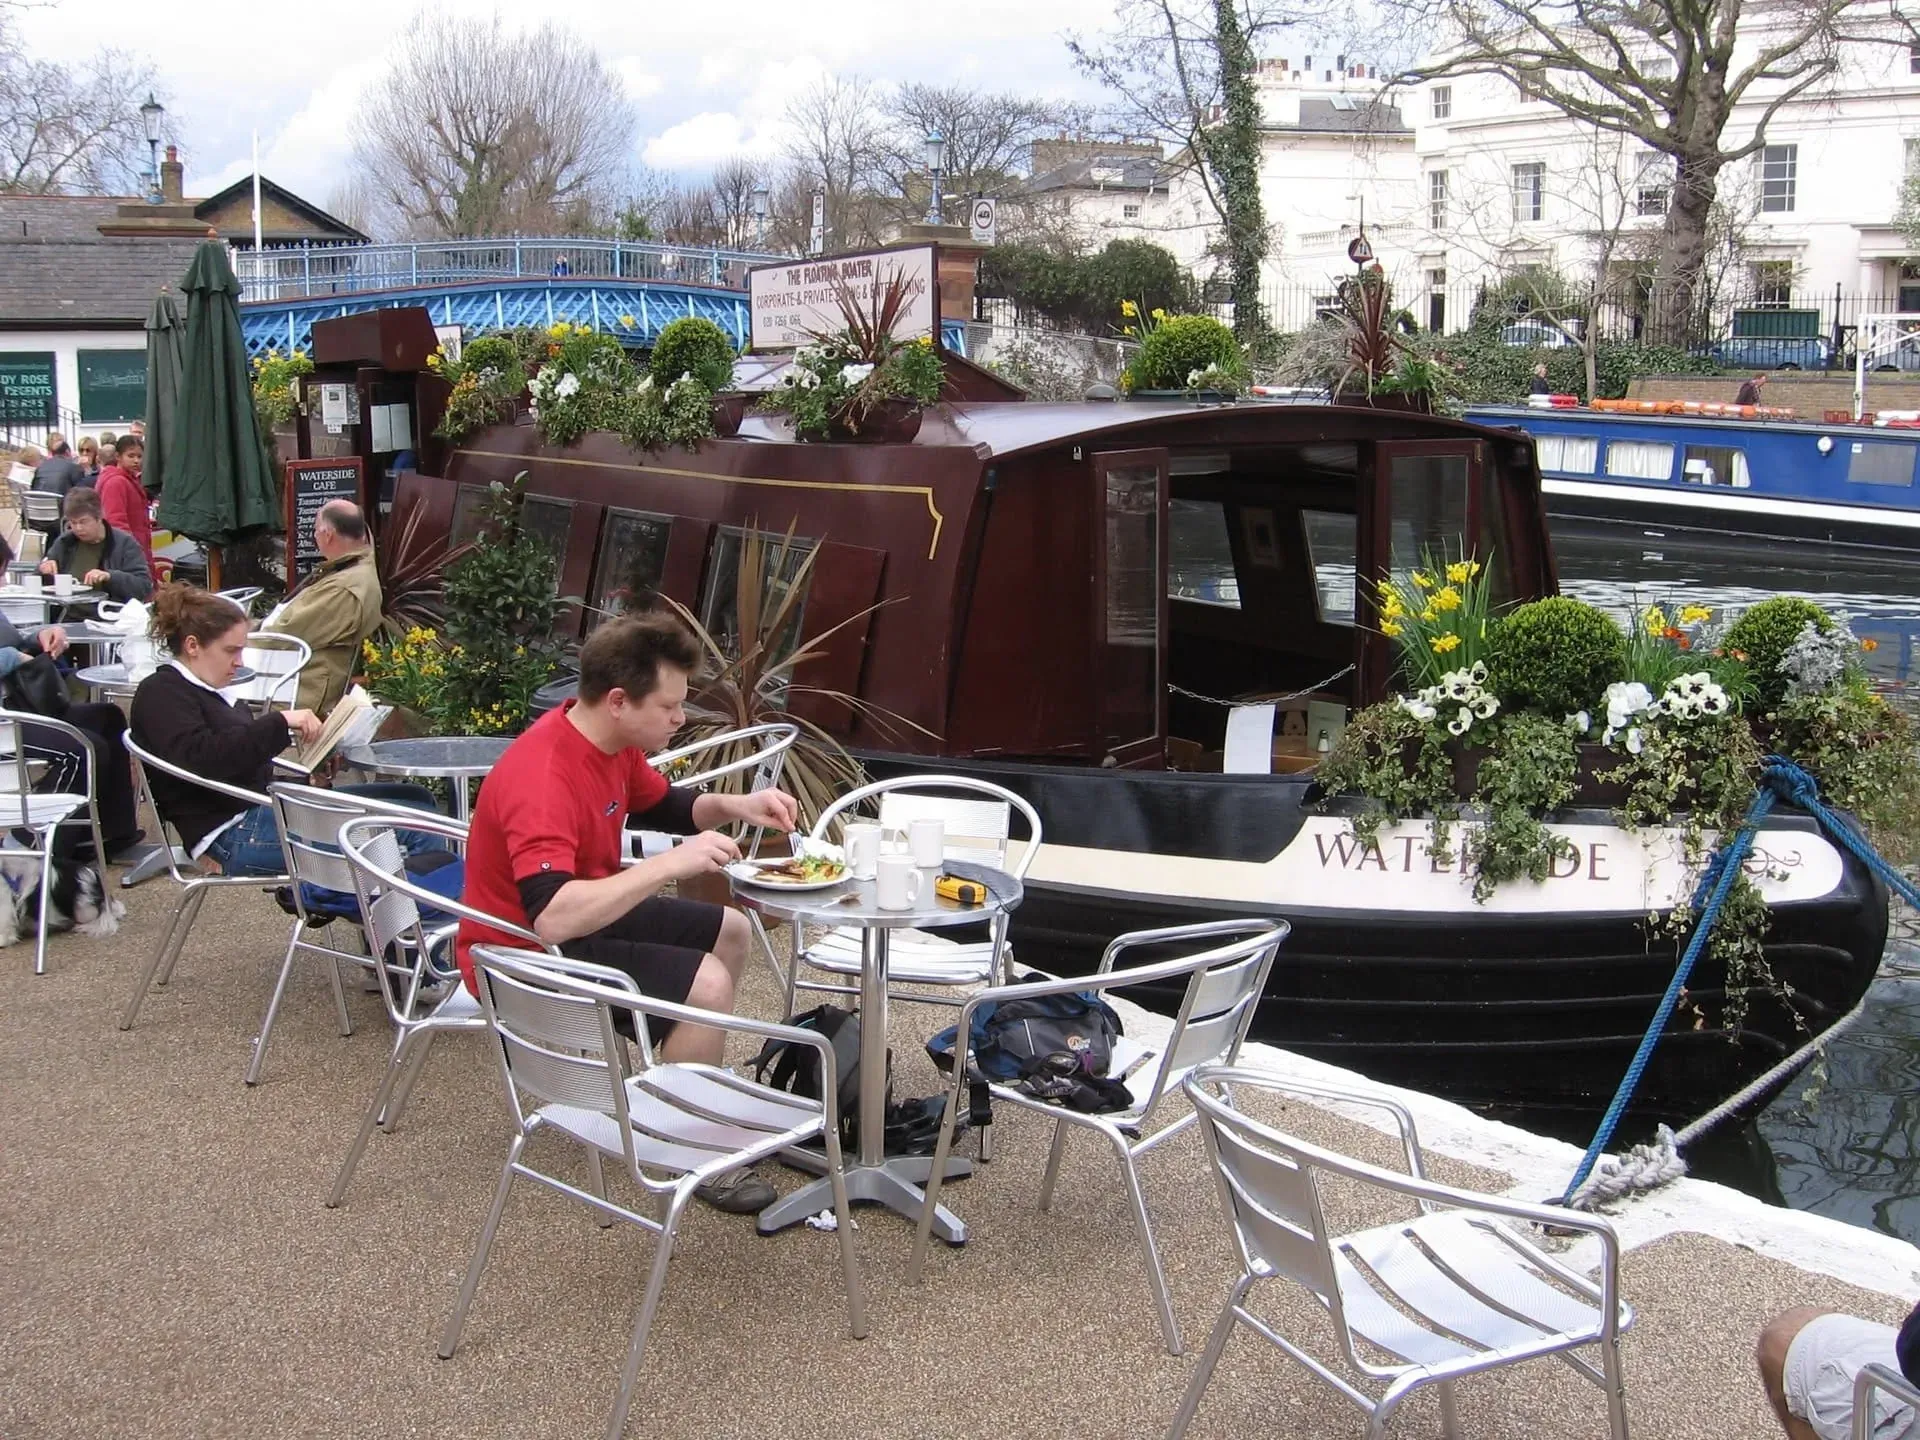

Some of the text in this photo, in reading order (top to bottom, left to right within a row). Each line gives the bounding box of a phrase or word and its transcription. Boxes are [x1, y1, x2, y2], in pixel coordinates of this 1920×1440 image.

[787, 269, 801, 286] THE
[756, 292, 796, 310] CORPORATE
[803, 287, 834, 305] PRIVATE
[0, 374, 49, 385] DY ROSE
[300, 469, 355, 481] WATERSIDE
[313, 481, 337, 490] CAFE
[1314, 833, 1611, 881] WATEDE
